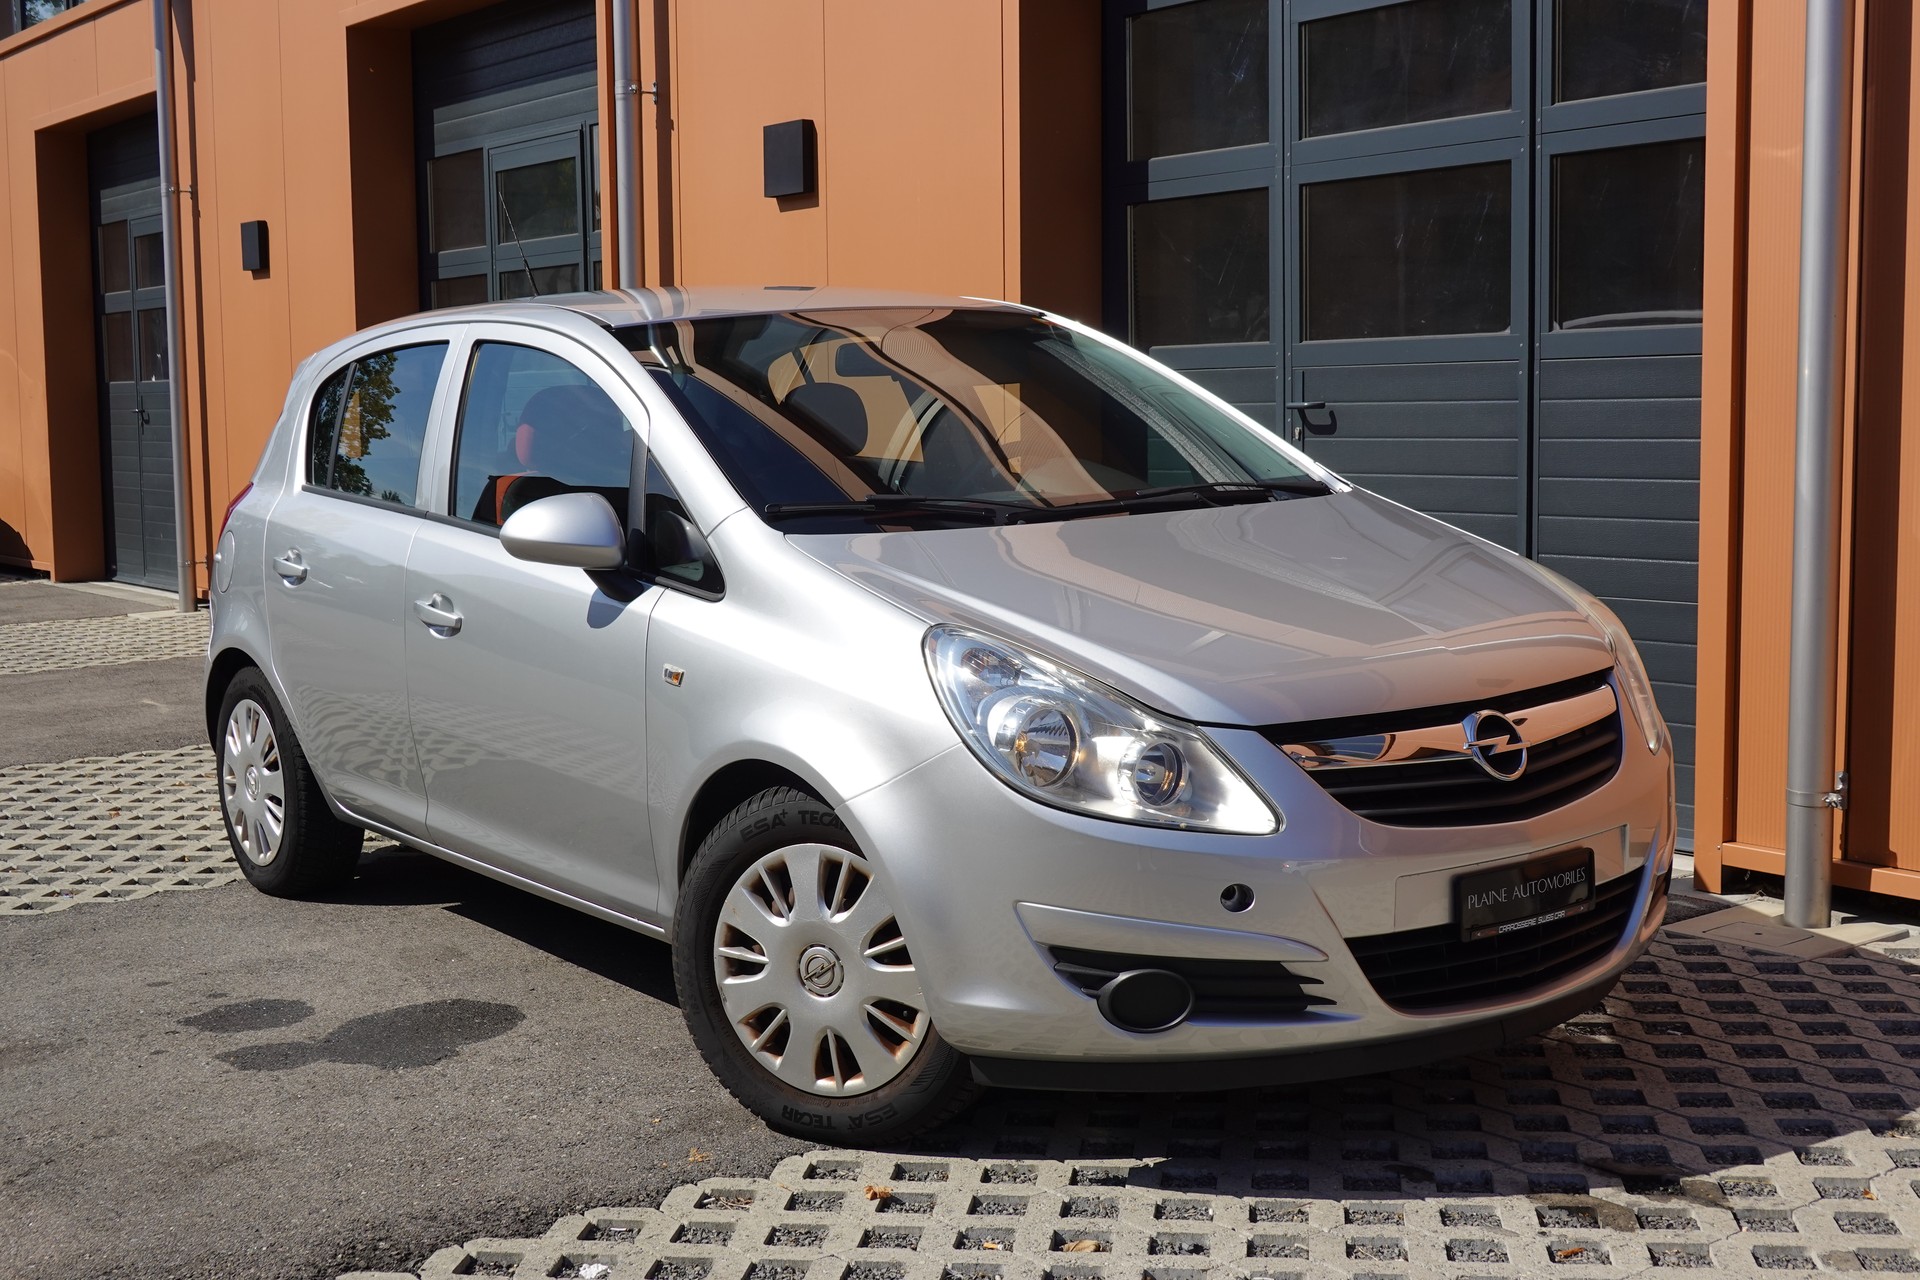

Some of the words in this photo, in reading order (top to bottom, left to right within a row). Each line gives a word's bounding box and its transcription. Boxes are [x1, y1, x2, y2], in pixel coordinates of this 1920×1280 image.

[1468, 888, 1508, 909] PLAINE
[1512, 867, 1586, 900] AUTOMOBILES
[1498, 918, 1537, 934] CARROSSERIE
[1538, 913, 1554, 924] SWISS
[1554, 910, 1566, 920] CAR
[781, 1104, 836, 1130] TECAR
